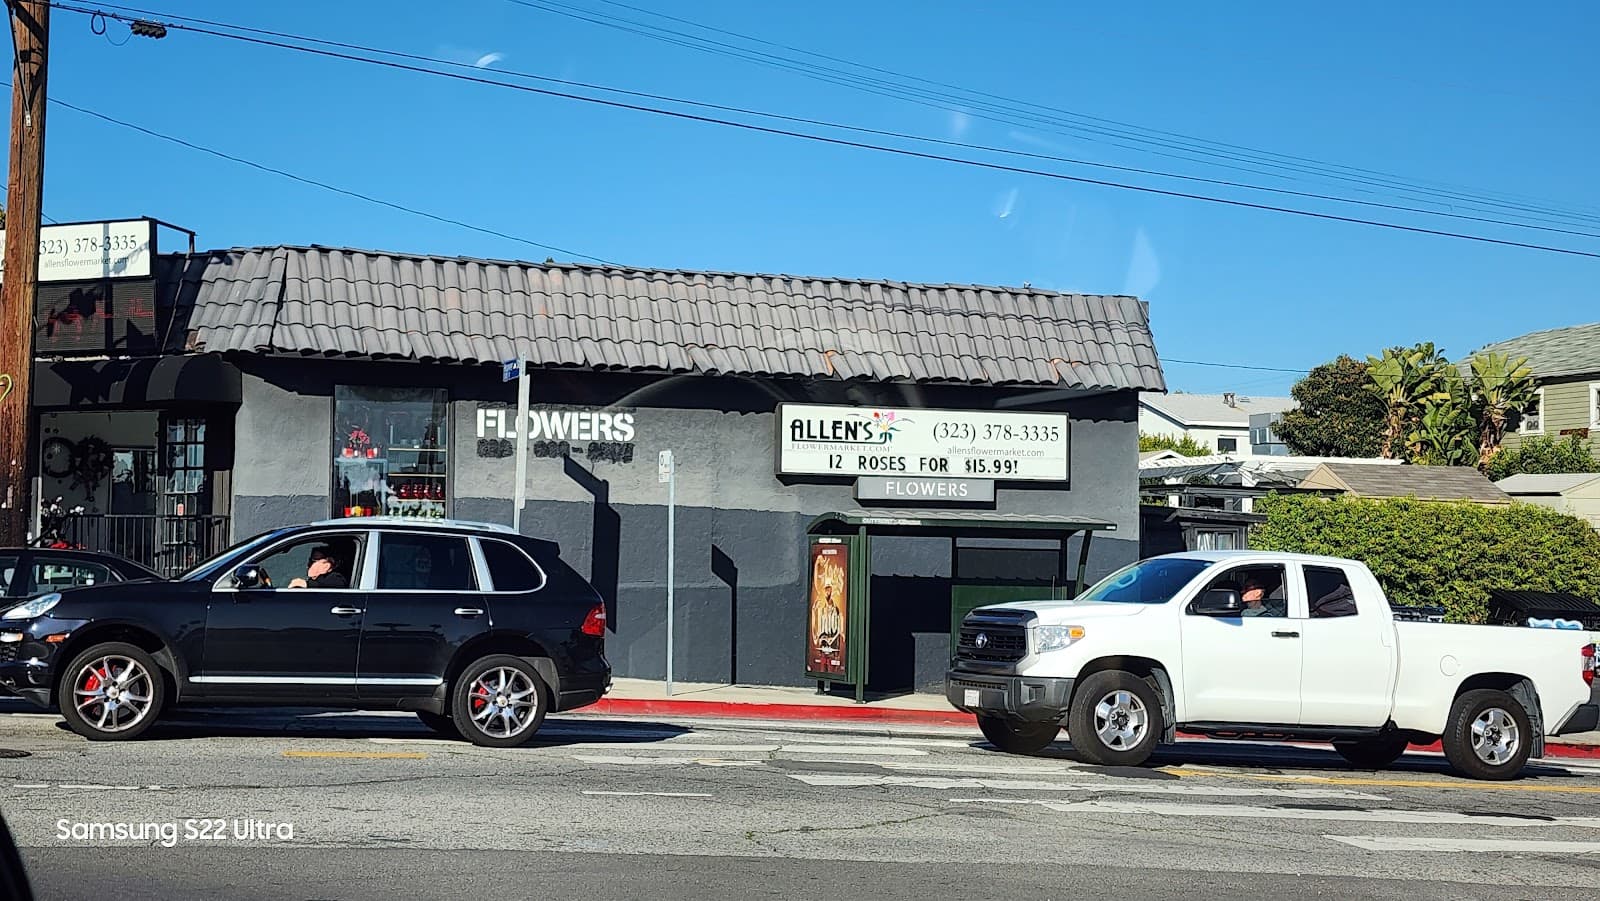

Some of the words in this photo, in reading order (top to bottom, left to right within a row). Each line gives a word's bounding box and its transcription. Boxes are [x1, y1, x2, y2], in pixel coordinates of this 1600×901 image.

[39, 238, 69, 258] 323)
[73, 234, 138, 254] 378-3335
[44, 256, 129, 269] allensflowermarket.com
[476, 408, 635, 442] FLOWERS
[790, 418, 873, 441] ALLEN'S
[933, 422, 976, 444] (323)
[982, 424, 1059, 442] 378-3335
[791, 442, 891, 453] FLOWERMARKET.COM
[947, 446, 1045, 457] allensflowermarket.com
[829, 454, 843, 469] 12
[858, 455, 906, 472] ROSES
[919, 457, 949, 473] FOR
[965, 458, 1018, 474] $15.99!
[886, 481, 968, 497] FLOWERS
